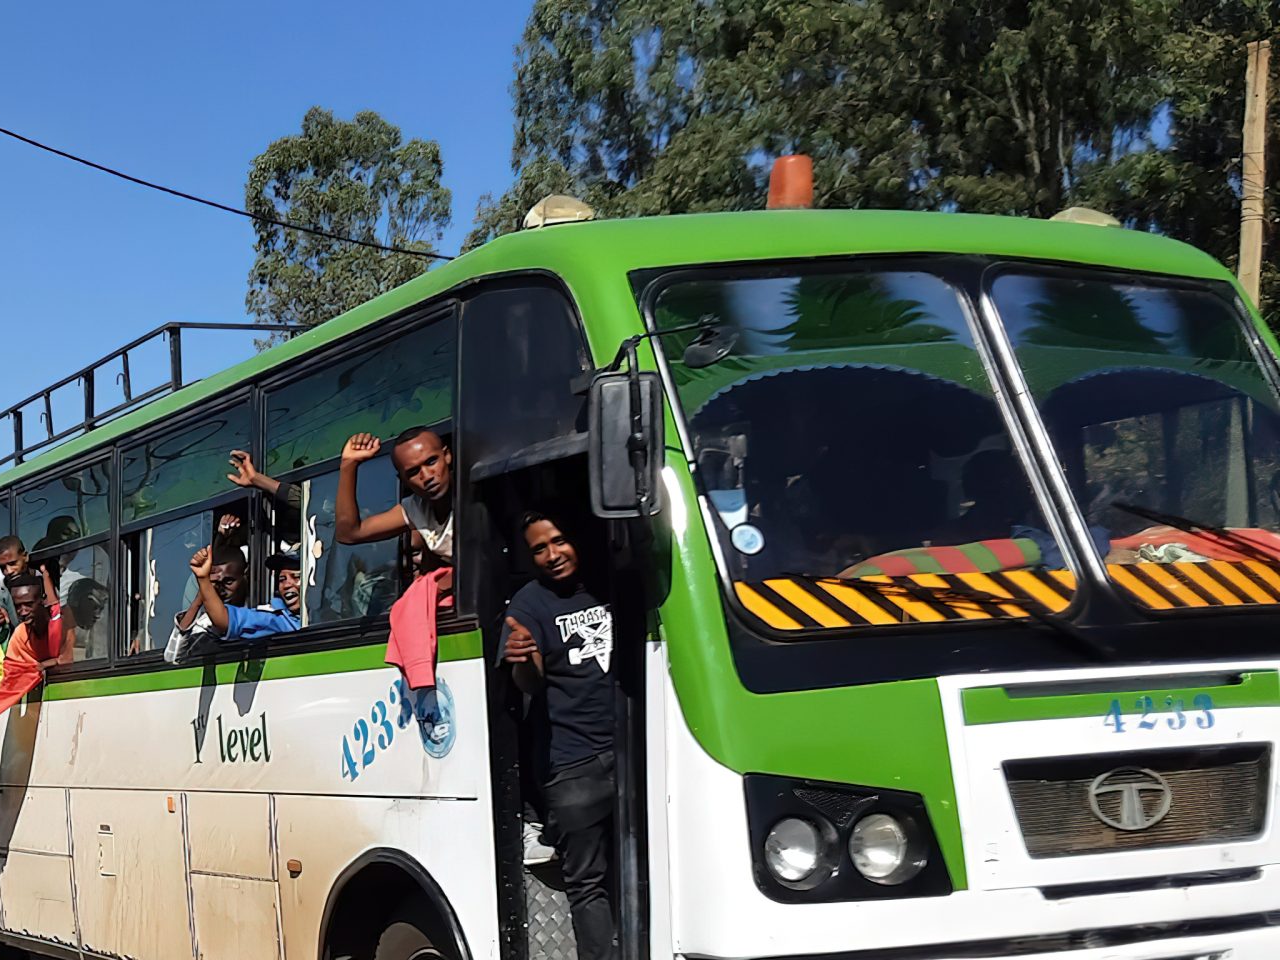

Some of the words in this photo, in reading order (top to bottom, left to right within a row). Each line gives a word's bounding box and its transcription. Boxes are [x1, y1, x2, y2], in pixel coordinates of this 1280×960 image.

[216, 711, 271, 763] level
[341, 678, 413, 783] 4233
[1103, 693, 1216, 733] 4233
